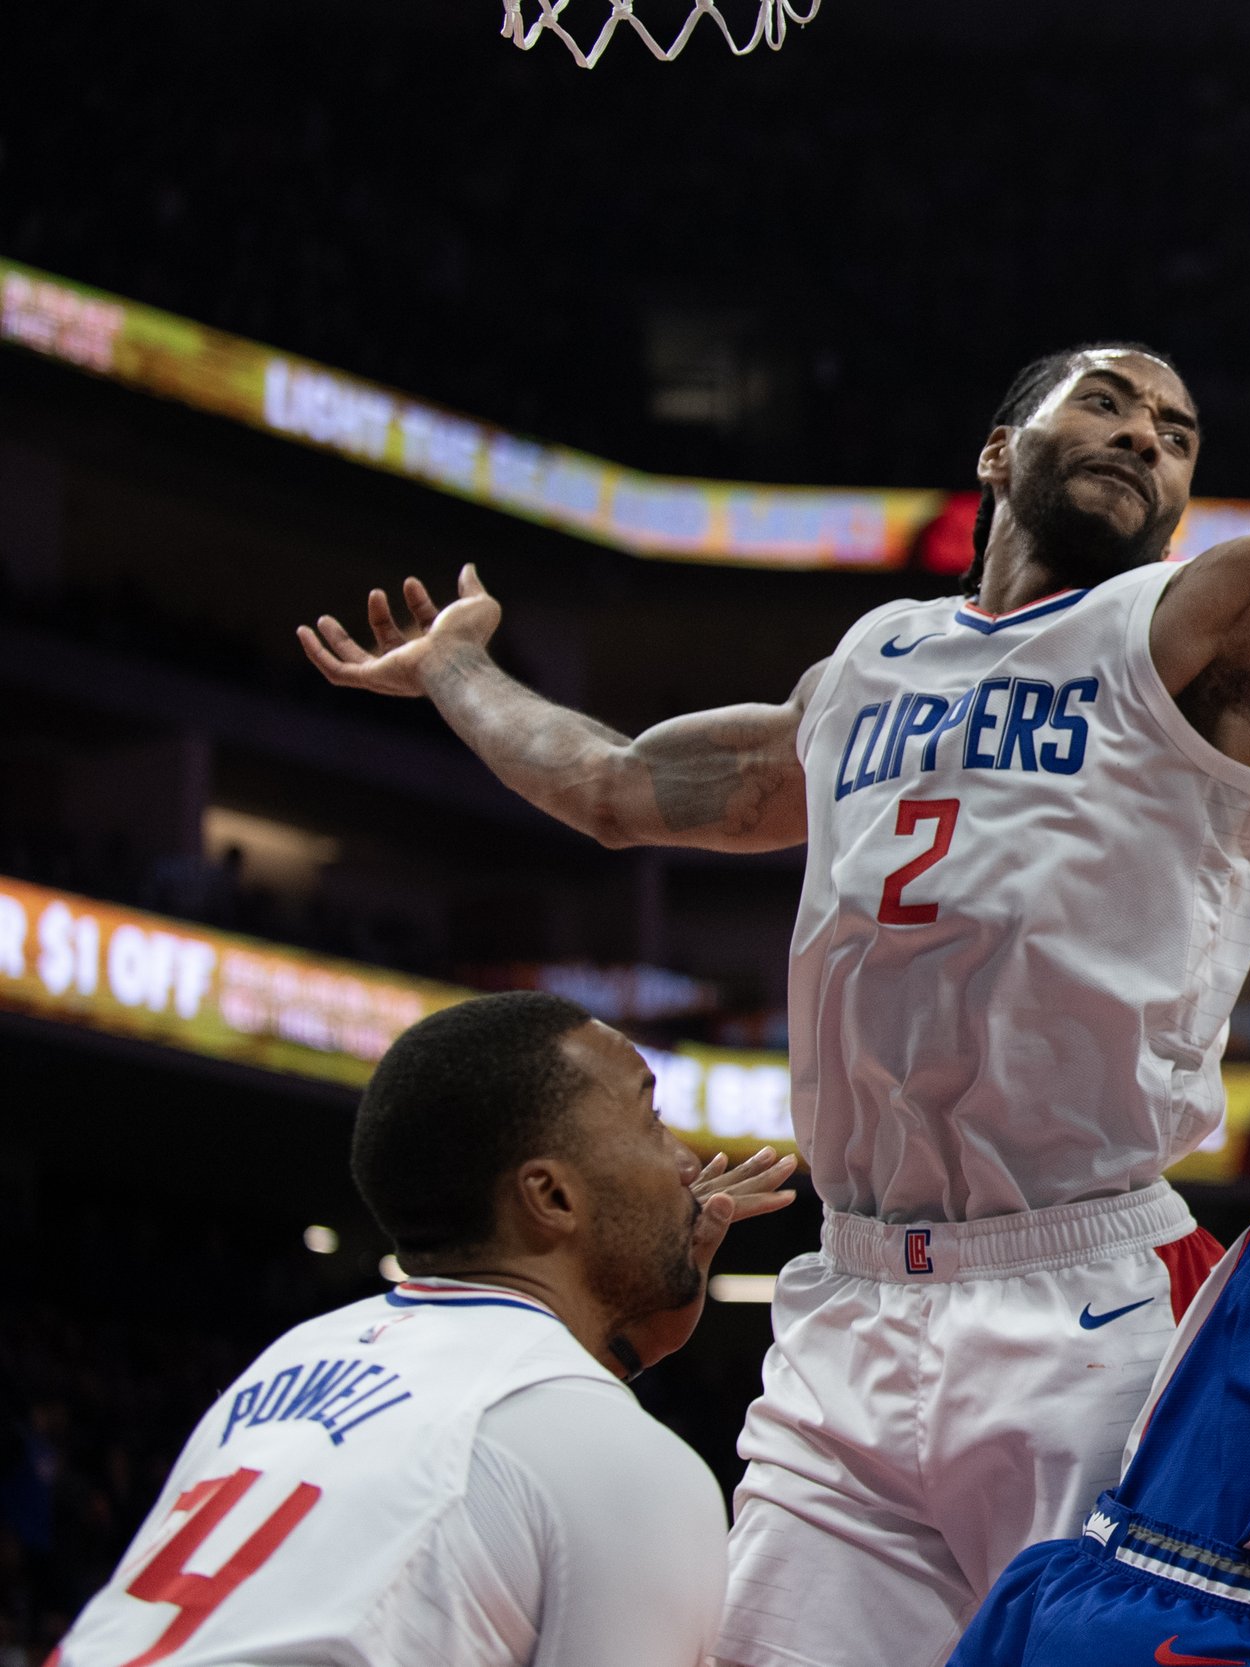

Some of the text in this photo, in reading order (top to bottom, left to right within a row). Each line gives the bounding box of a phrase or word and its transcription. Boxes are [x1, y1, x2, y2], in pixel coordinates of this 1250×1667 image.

[835, 677, 1099, 801] CLIPPERS
[877, 798, 960, 925] 2
[38, 900, 99, 996] $1
[108, 923, 216, 1020] OFF
[219, 1360, 412, 1448] POWELL
